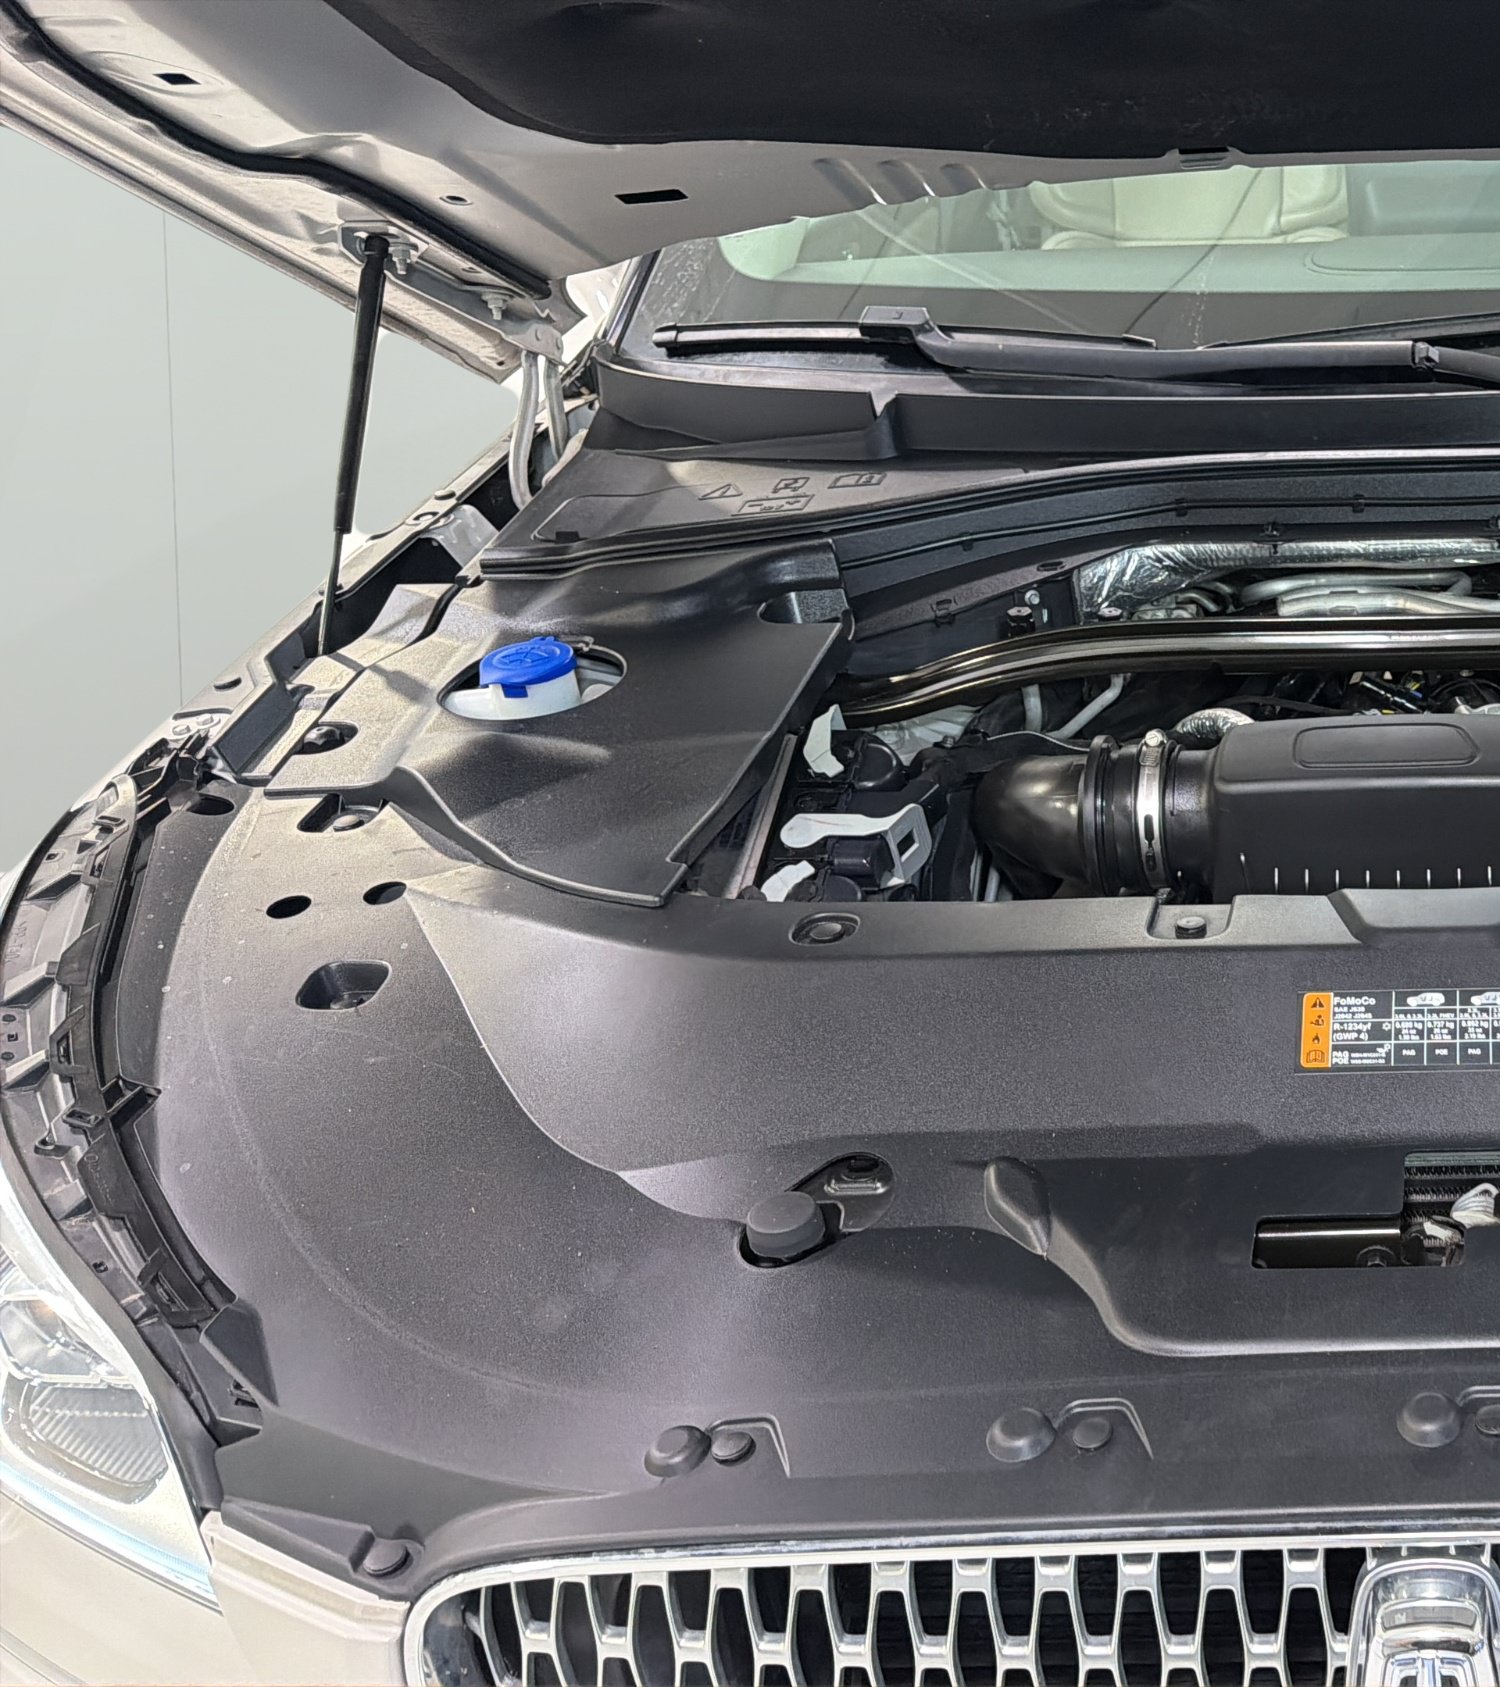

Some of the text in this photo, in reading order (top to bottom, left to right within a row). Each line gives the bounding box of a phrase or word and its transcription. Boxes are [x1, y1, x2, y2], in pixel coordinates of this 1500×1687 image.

[1333, 997, 1376, 1005] FoMoCo
[1333, 1022, 1372, 1031] R-1234yf
[1333, 1032, 1368, 1041] (GWP 4)
